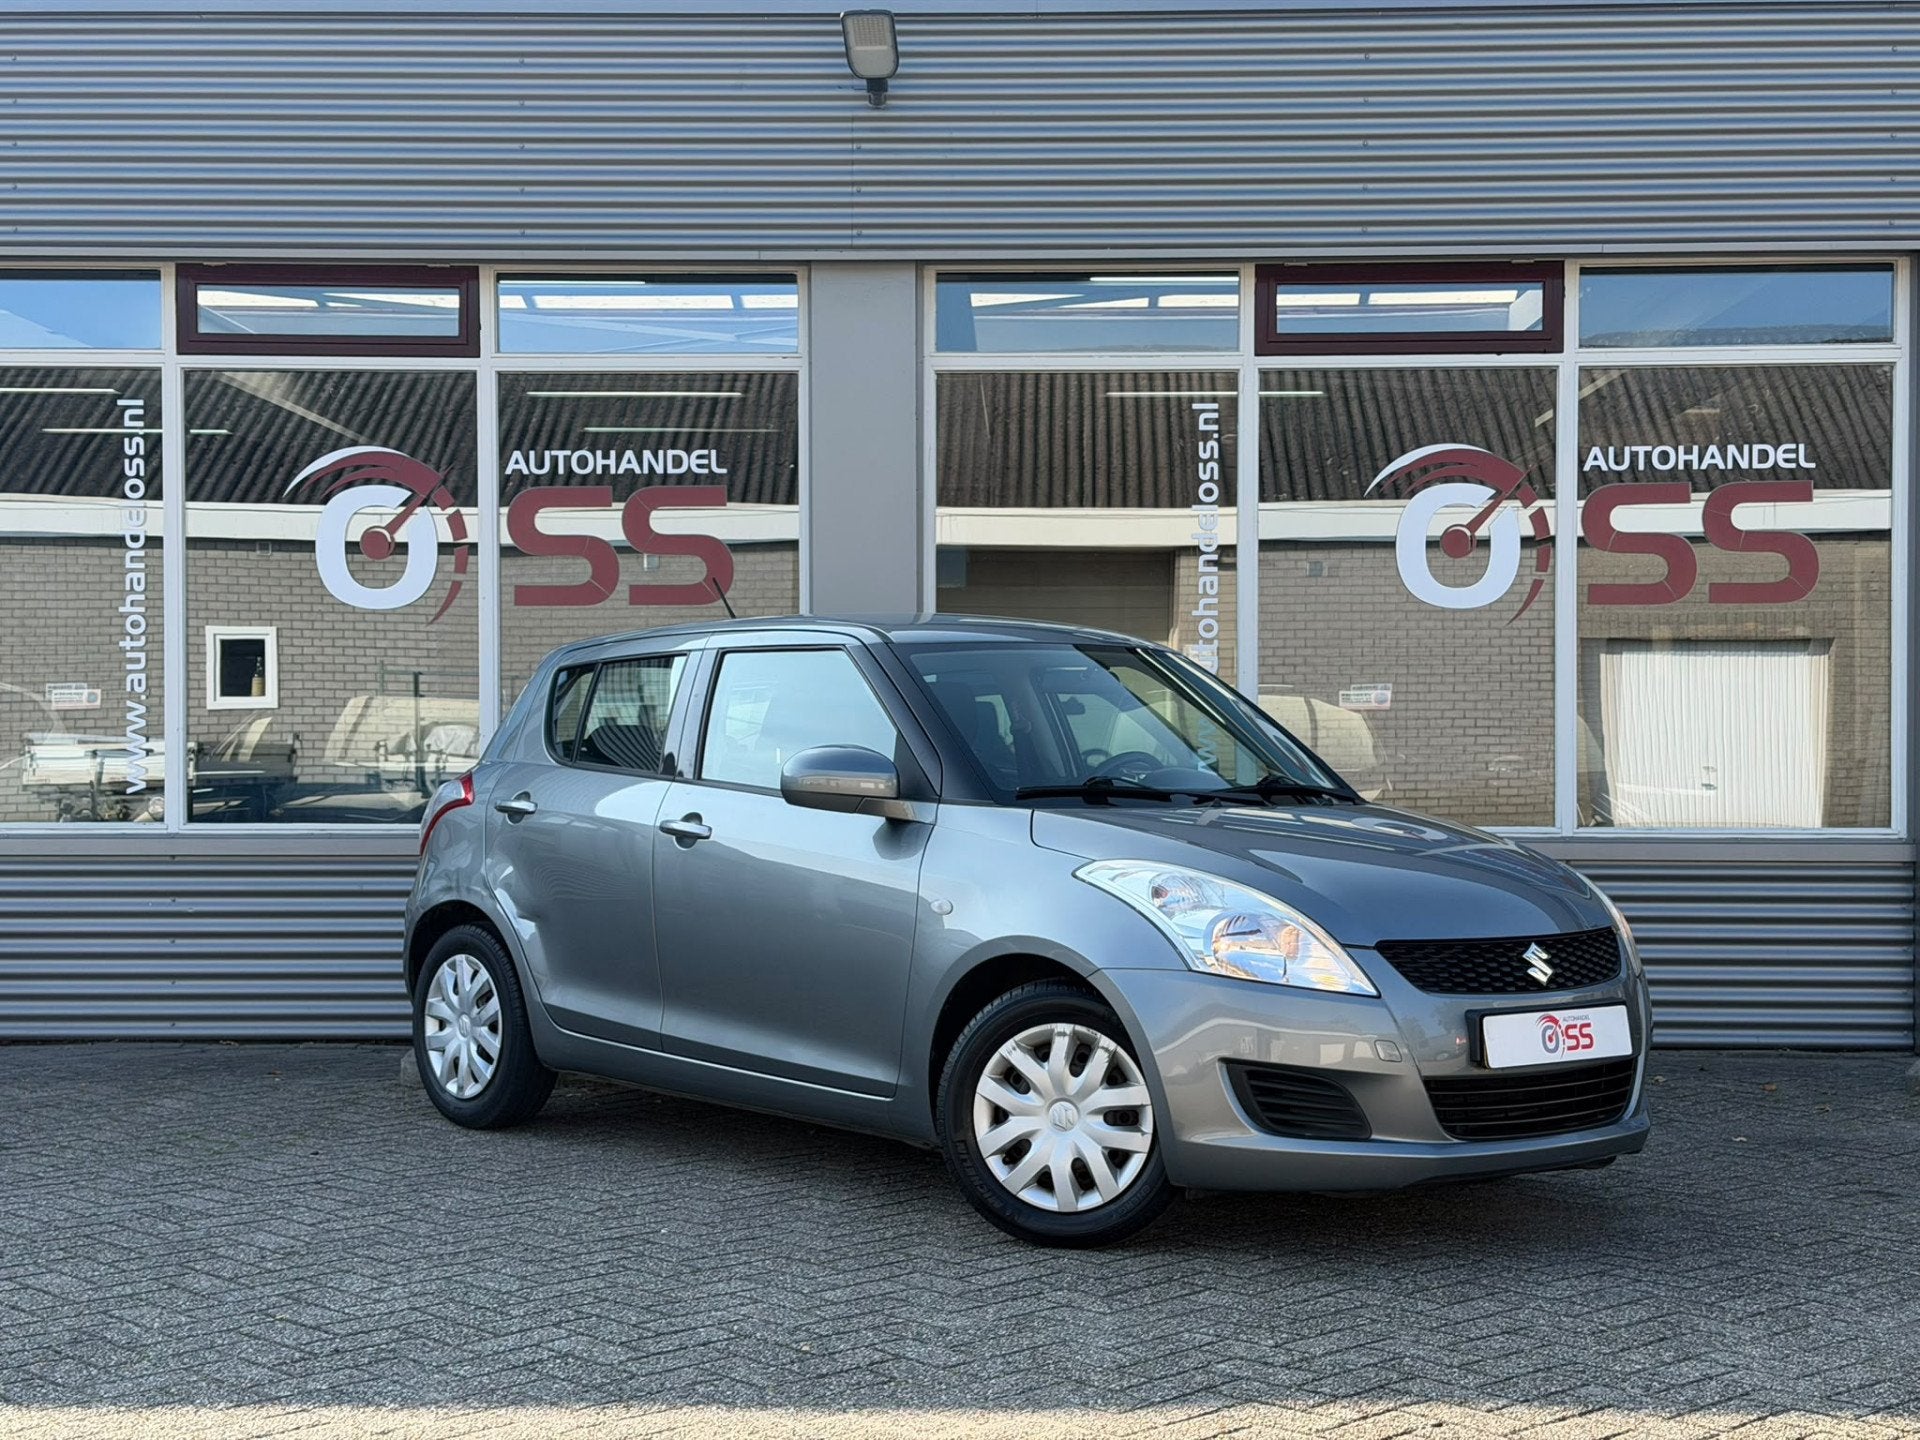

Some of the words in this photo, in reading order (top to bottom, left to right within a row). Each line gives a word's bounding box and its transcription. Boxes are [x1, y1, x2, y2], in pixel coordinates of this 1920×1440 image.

[505, 449, 728, 475] AUTOHANDEL
[1583, 443, 1816, 472] AUTOHANDEL
[117, 399, 147, 794] www.autohandeloss.nl
[1541, 1022, 1594, 1054] OSS
